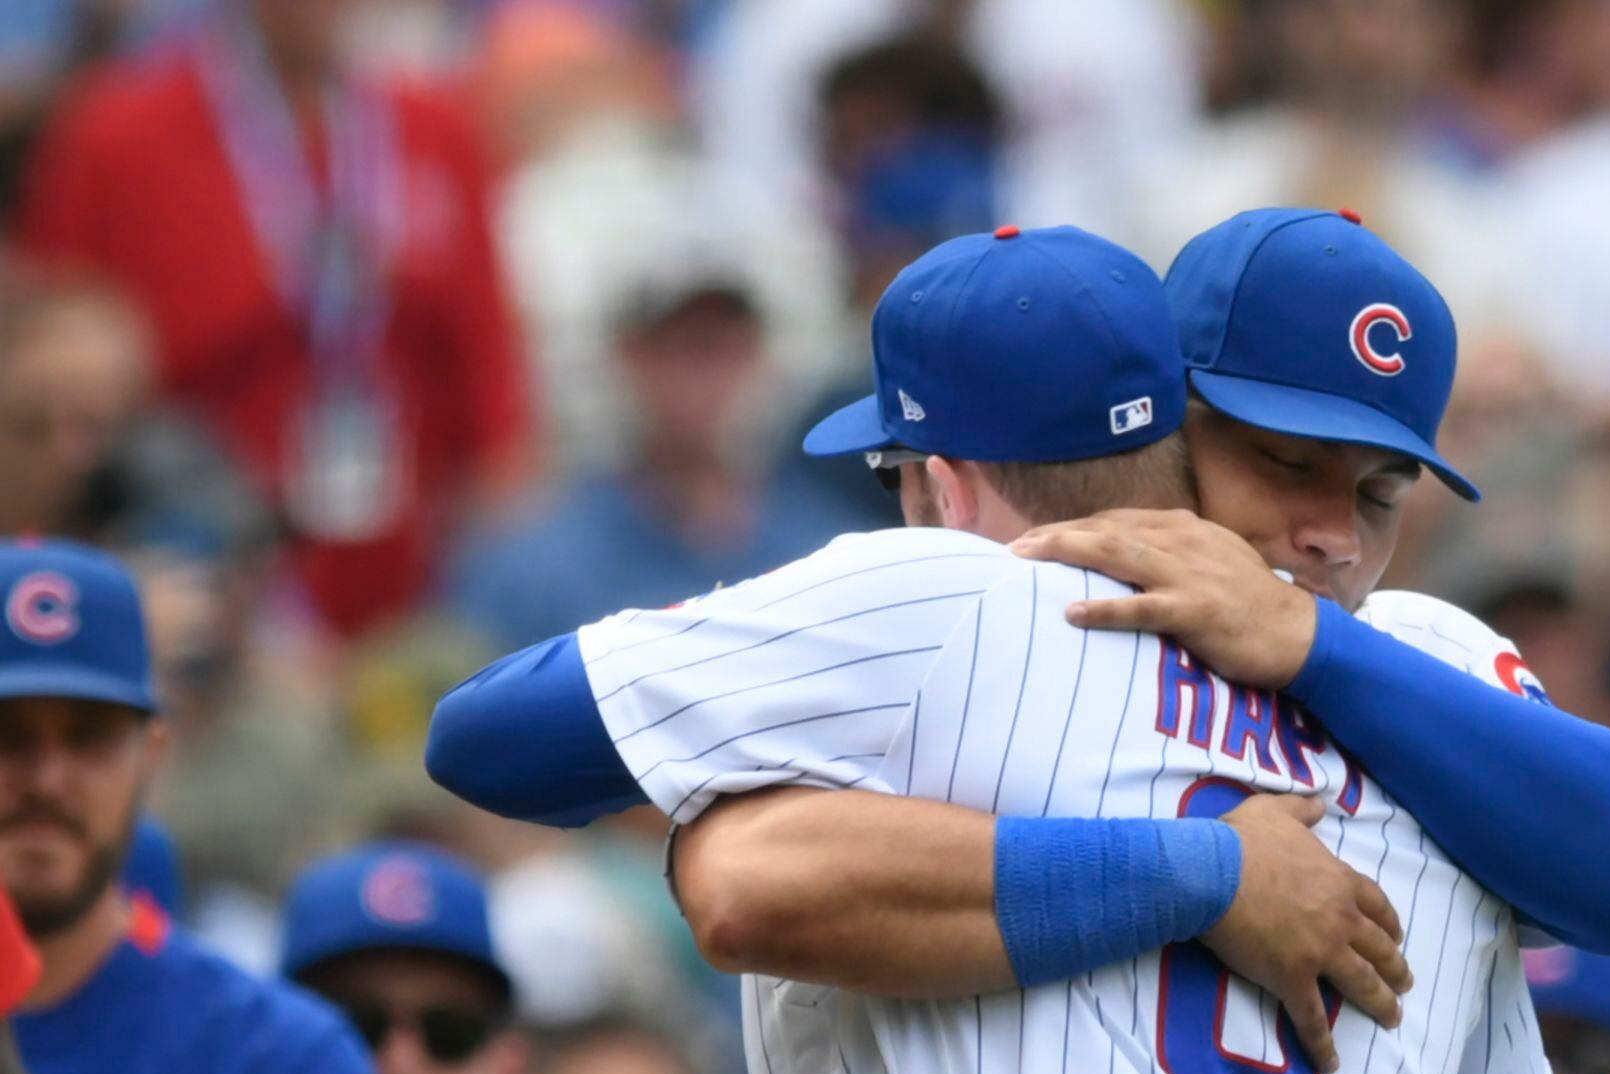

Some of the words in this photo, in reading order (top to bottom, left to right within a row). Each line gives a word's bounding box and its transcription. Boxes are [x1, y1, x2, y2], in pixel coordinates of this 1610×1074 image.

[1348, 302, 1413, 378] C
[3, 571, 82, 646] C
[1155, 634, 1364, 817] HAP
